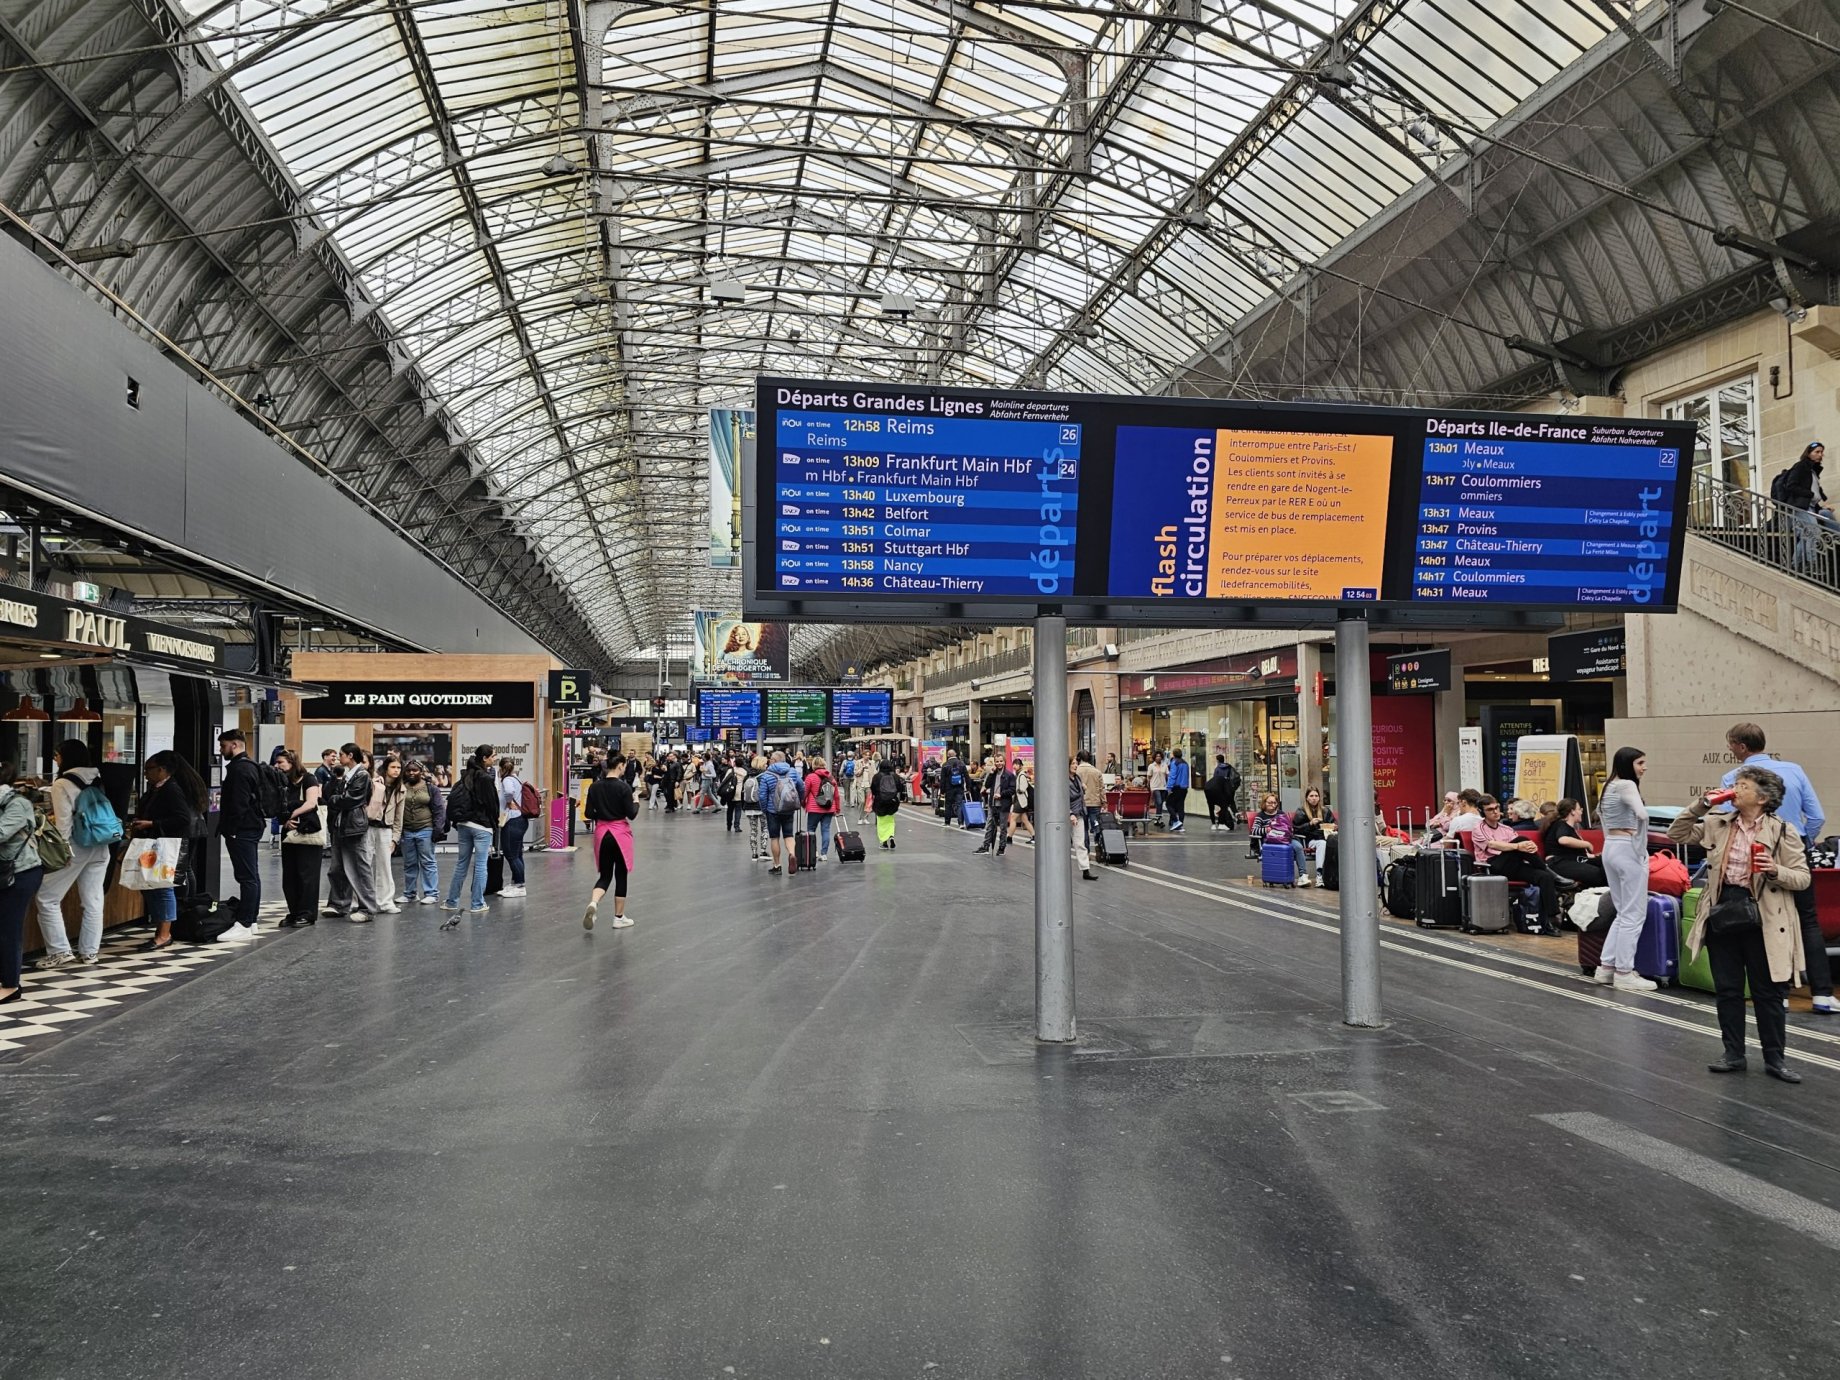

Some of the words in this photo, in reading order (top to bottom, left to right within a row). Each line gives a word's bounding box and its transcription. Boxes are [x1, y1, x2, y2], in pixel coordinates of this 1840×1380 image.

[777, 388, 848, 409] Départs
[853, 392, 925, 411] Grandes
[930, 396, 984, 416] Lignes
[990, 400, 1025, 409] Mainline
[1026, 402, 1069, 412] departures
[989, 410, 1021, 419] Abfahrt
[1023, 411, 1069, 421] Fernverkehr
[843, 420, 880, 432] 12h58
[887, 418, 934, 435] Reims
[1062, 428, 1076, 440] 26
[1426, 418, 1485, 438] Départs
[1489, 421, 1587, 440] Ile-de-France
[1592, 426, 1624, 434] Suburban
[1628, 428, 1664, 437] departures
[807, 433, 847, 446] Reims
[1230, 439, 1285, 450] interrompue
[1288, 441, 1310, 450] entre
[1313, 442, 1352, 452] Paris-Est
[1591, 436, 1617, 444] Abfahrt
[1618, 437, 1658, 446] Nahverkehr
[1229, 453, 1288, 464] Coulommiers
[1290, 456, 1300, 464] et
[1302, 456, 1336, 466] Provins.
[1428, 442, 1458, 454] 13h01
[1464, 442, 1504, 455] Meaux
[1661, 452, 1674, 464] 22
[843, 456, 880, 468] 13h09
[886, 454, 958, 471] Frankfurt
[962, 457, 999, 472] Main
[1004, 458, 1032, 474] Hbf
[1060, 464, 1075, 475] 24
[1483, 458, 1515, 470] Meaux
[822, 470, 846, 482] Hbf
[857, 471, 917, 486] Frankfurt
[921, 474, 951, 487] Main
[956, 475, 978, 488] Hbf
[1228, 468, 1242, 476] Les
[1246, 468, 1274, 478] clients
[1276, 470, 1296, 479] sont
[1298, 470, 1326, 480] invités
[1329, 471, 1334, 480] à
[1228, 482, 1256, 492] rendre
[1258, 484, 1268, 492] en
[1271, 485, 1290, 494] gare
[1293, 484, 1303, 492] de
[1306, 484, 1352, 494] Nogent-le-
[1426, 475, 1456, 486] 13h17
[1461, 474, 1542, 490] Coulommiers
[842, 490, 875, 500] 13h40
[886, 490, 964, 507] Luxembourg
[1226, 496, 1260, 505] Perreux
[1262, 498, 1276, 508] par
[1278, 497, 1286, 506] le
[1289, 498, 1306, 506] RER
[1309, 498, 1314, 506] E
[1316, 498, 1328, 507] où
[1330, 500, 1340, 508] un
[1460, 491, 1503, 501] ommiers
[842, 508, 874, 518] 13h42
[885, 507, 929, 520] Belfort
[1180, 438, 1212, 596] circulation
[1225, 510, 1256, 520] service
[1258, 512, 1268, 520] de
[1271, 512, 1286, 520] bus
[1289, 512, 1300, 521] de
[1302, 513, 1364, 523] remplacement
[1423, 508, 1450, 518] 13h31
[1458, 507, 1495, 519] Meaux
[1029, 447, 1068, 594] départs
[842, 525, 874, 536] 13h51
[884, 524, 931, 537] Colmar
[1224, 525, 1238, 533] est
[1240, 525, 1256, 534] mis
[1271, 526, 1296, 536] place.
[1422, 524, 1450, 534] 13h47
[1457, 524, 1498, 535] Provins
[842, 542, 874, 552] 13h51
[884, 542, 942, 558] Stuttgart
[946, 544, 970, 556] Hbf
[1420, 540, 1448, 550] 13h47
[1456, 538, 1543, 554] Château-Thierry
[1626, 487, 1662, 603] départ
[1151, 525, 1178, 597] flash
[1222, 552, 1243, 561] Pour
[1245, 552, 1282, 563] préparer
[1302, 554, 1364, 564] déplacements,
[1419, 556, 1446, 566] 14h01
[1454, 555, 1491, 566] Meaux
[842, 560, 874, 570] 13h58
[884, 559, 924, 574] Nancy
[1222, 567, 1274, 576] rendez-vous
[1293, 568, 1300, 576] le
[1303, 568, 1319, 576] site
[1418, 572, 1446, 581] 14h17
[1453, 570, 1526, 583] Coulommiers
[841, 577, 874, 588] 14h36
[883, 576, 984, 592] Château-Thierry
[1346, 590, 1354, 598] 12
[1356, 590, 1365, 598] 54
[1416, 588, 1444, 597] 14h31
[1452, 586, 1488, 598] Meaux
[66, 607, 131, 651] PAUL
[145, 632, 216, 662] VIENNOISERIES
[344, 694, 365, 704] LE
[368, 694, 405, 704] PAIN
[408, 694, 493, 706] QUOTIDIEN
[1702, 753, 1720, 764] AUX
[1690, 786, 1702, 796] DU
